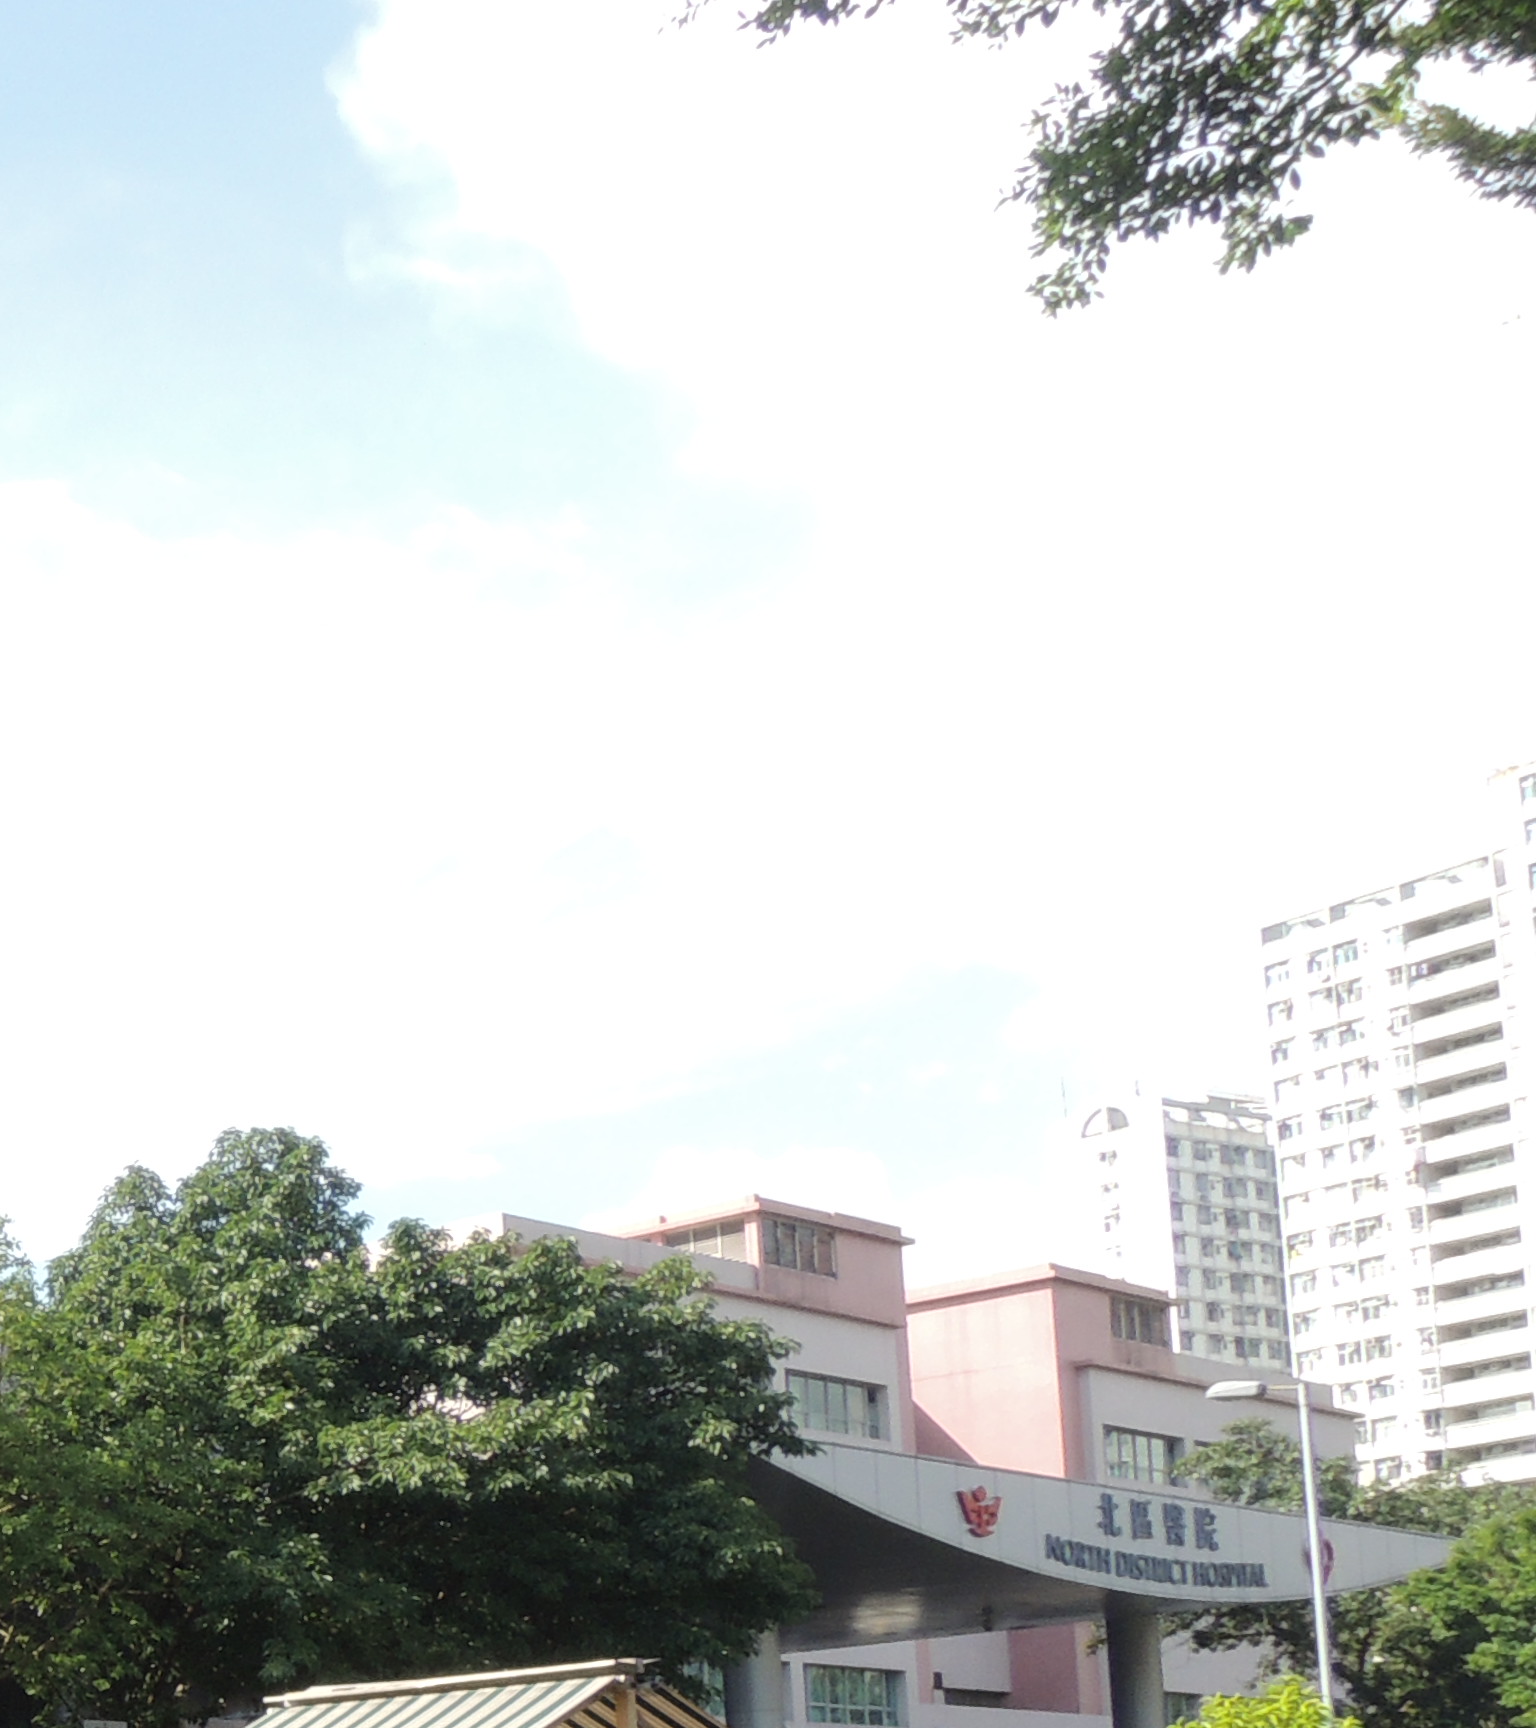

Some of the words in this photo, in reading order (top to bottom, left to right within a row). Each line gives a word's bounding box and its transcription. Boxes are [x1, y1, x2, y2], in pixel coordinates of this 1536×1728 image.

[1096, 1492, 1219, 1551] 北區醫院
[1045, 1533, 1111, 1574] NORTH
[1115, 1551, 1187, 1585] DISTRICT
[1192, 1562, 1269, 1588] HOSPITAL
